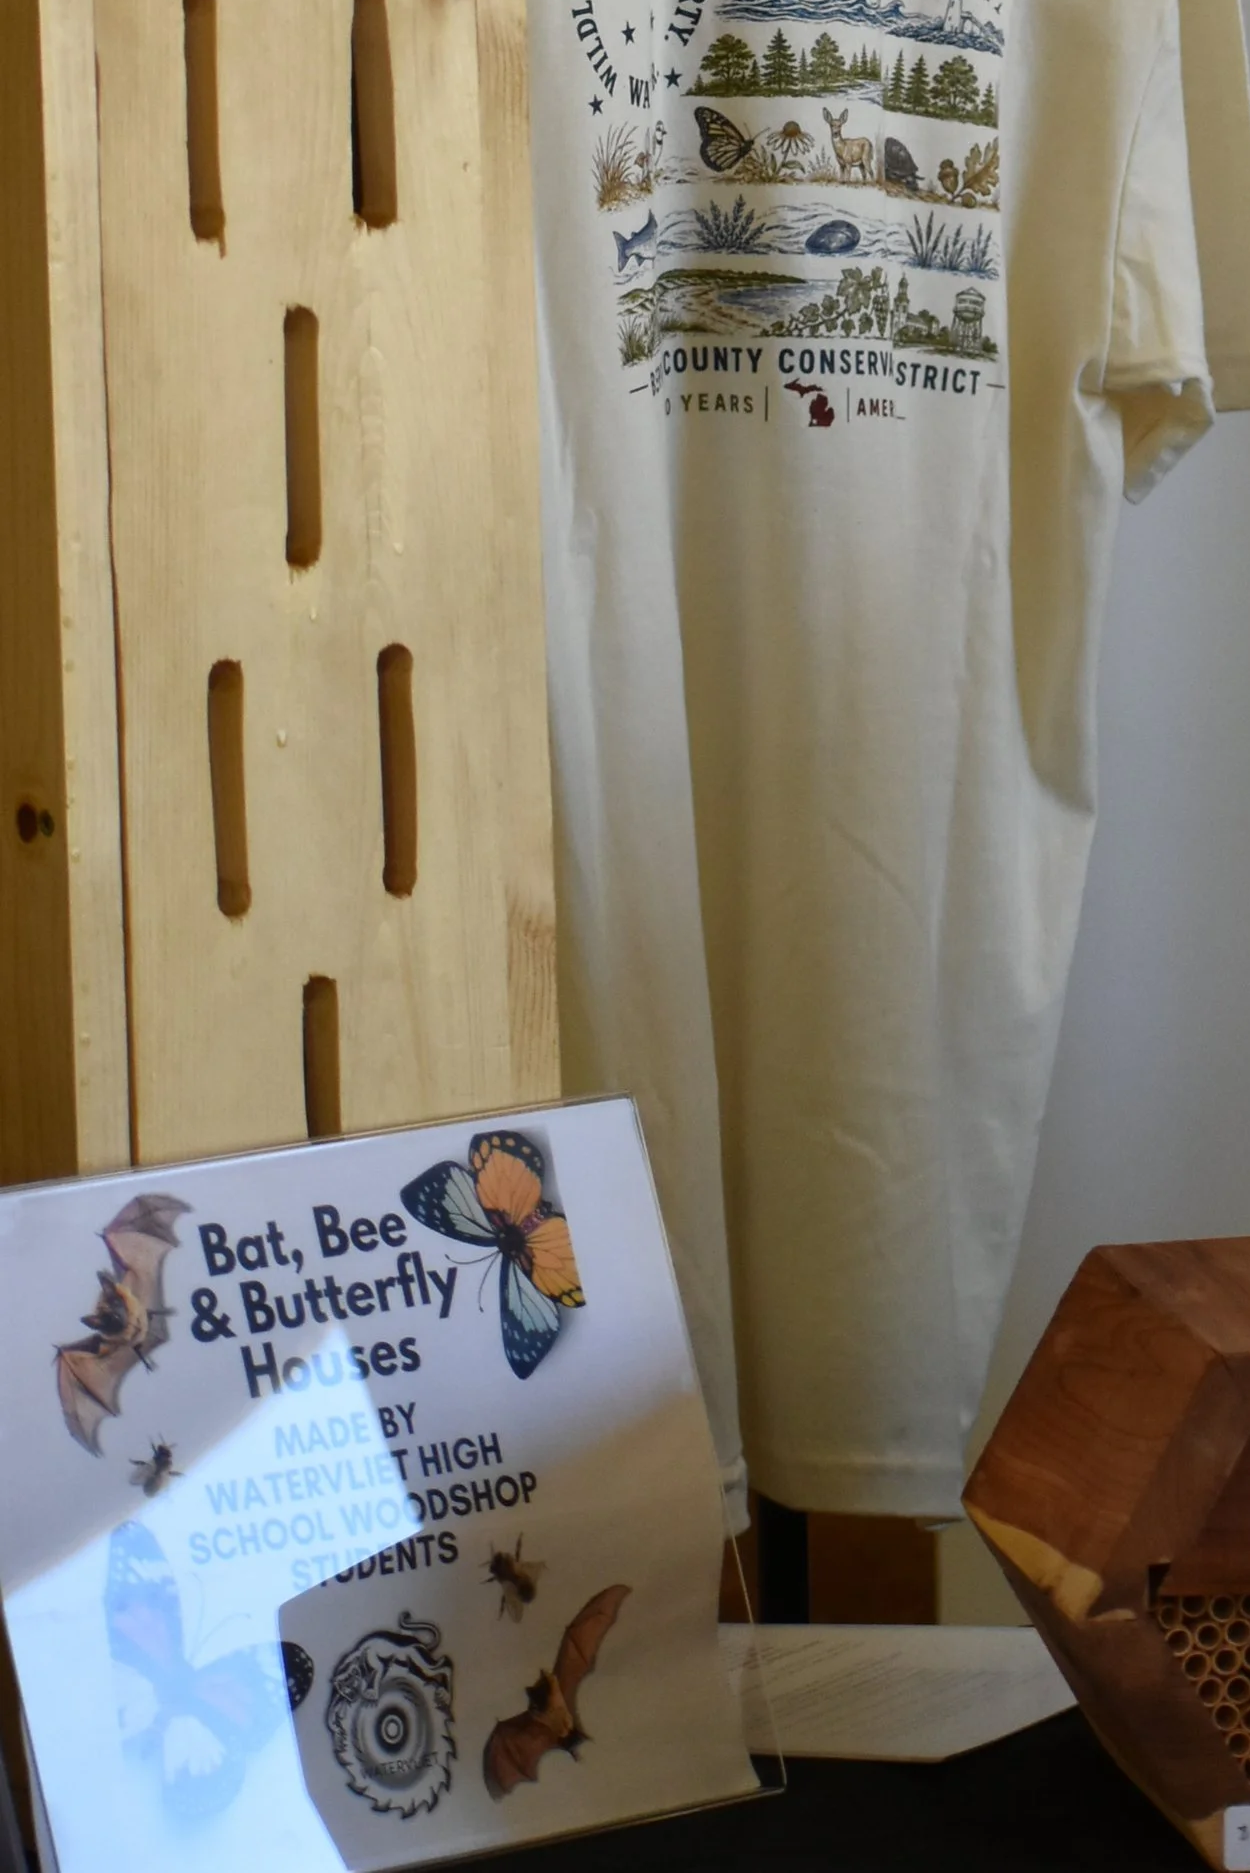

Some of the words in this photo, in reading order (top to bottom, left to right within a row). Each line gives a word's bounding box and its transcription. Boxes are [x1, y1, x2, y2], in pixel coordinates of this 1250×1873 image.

[661, 345, 763, 375] COUNTY
[894, 360, 981, 396] STRICT
[680, 392, 755, 415] YEARS
[198, 1220, 305, 1277] Bat,
[312, 1204, 408, 1258] Bee
[190, 1286, 237, 1343] &
[239, 1250, 458, 1335] Butterfly
[240, 1336, 422, 1399] Houses
[274, 1410, 372, 1459] MADE
[378, 1401, 417, 1439] BY
[205, 1448, 408, 1516] WATERVLIET
[418, 1431, 504, 1478] HIGH
[188, 1510, 334, 1566] SCHOOL
[341, 1470, 538, 1538] WOODSHOP
[290, 1531, 460, 1592] STUDENTS
